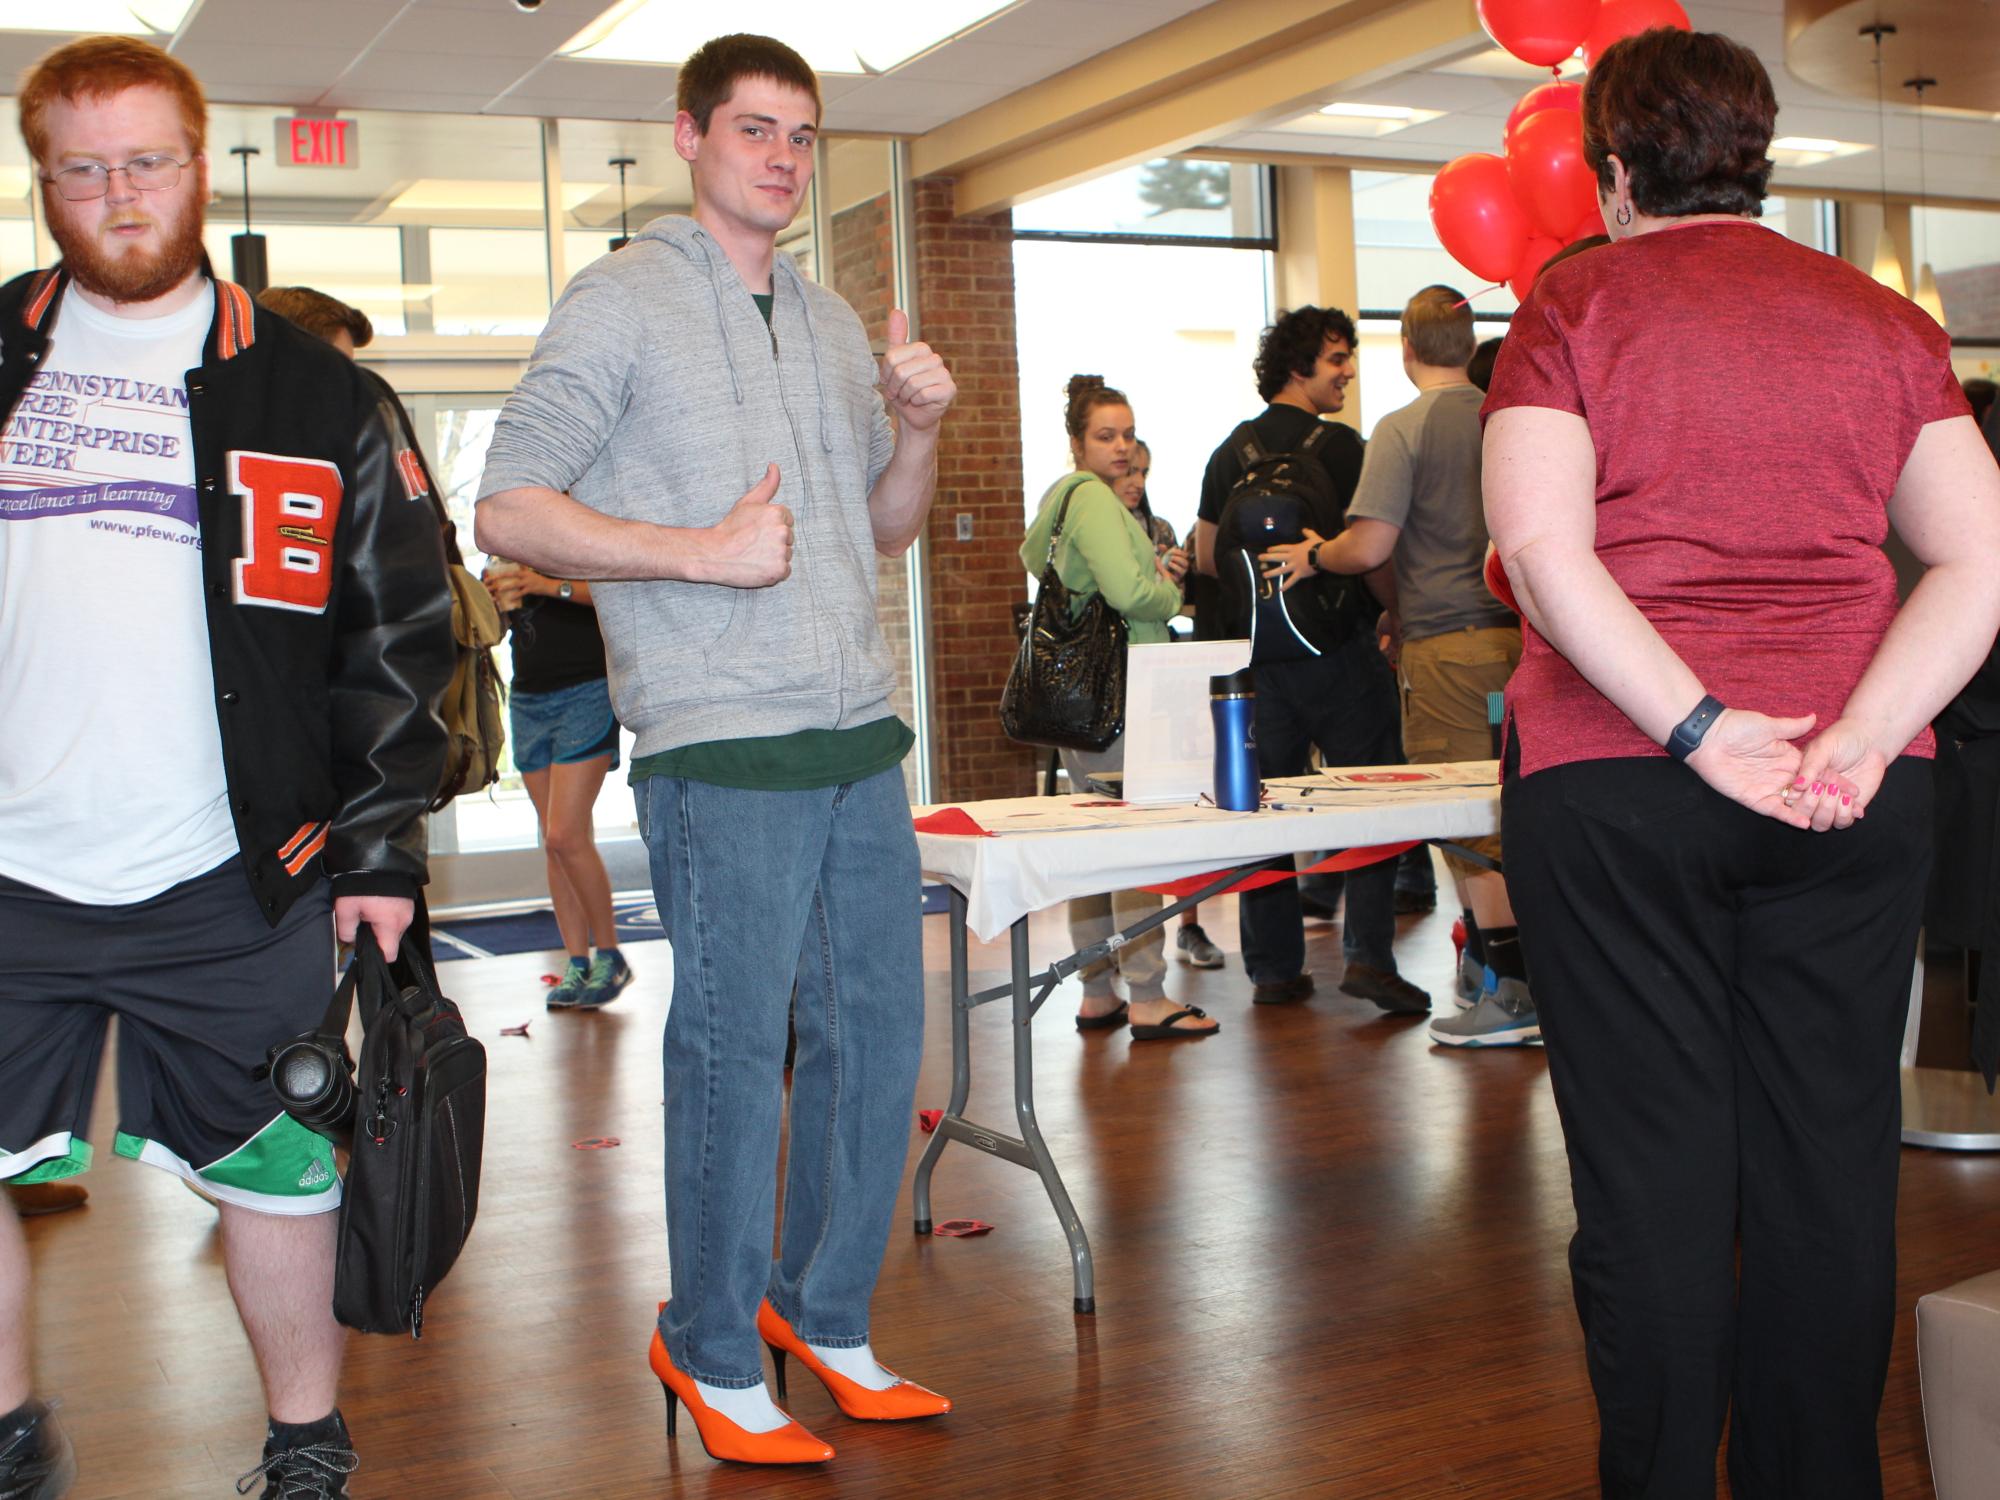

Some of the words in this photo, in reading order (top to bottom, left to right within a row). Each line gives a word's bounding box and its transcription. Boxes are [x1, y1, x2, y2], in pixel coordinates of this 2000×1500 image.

[290, 119, 349, 165] EXIT
[19, 391, 78, 418] REE
[30, 371, 189, 409] ENNSYLVAN
[81, 489, 97, 506] in
[102, 485, 177, 511] learning
[90, 520, 202, 550] www.pfew.org
[225, 450, 344, 615] B
[299, 1172, 329, 1186] adidas
